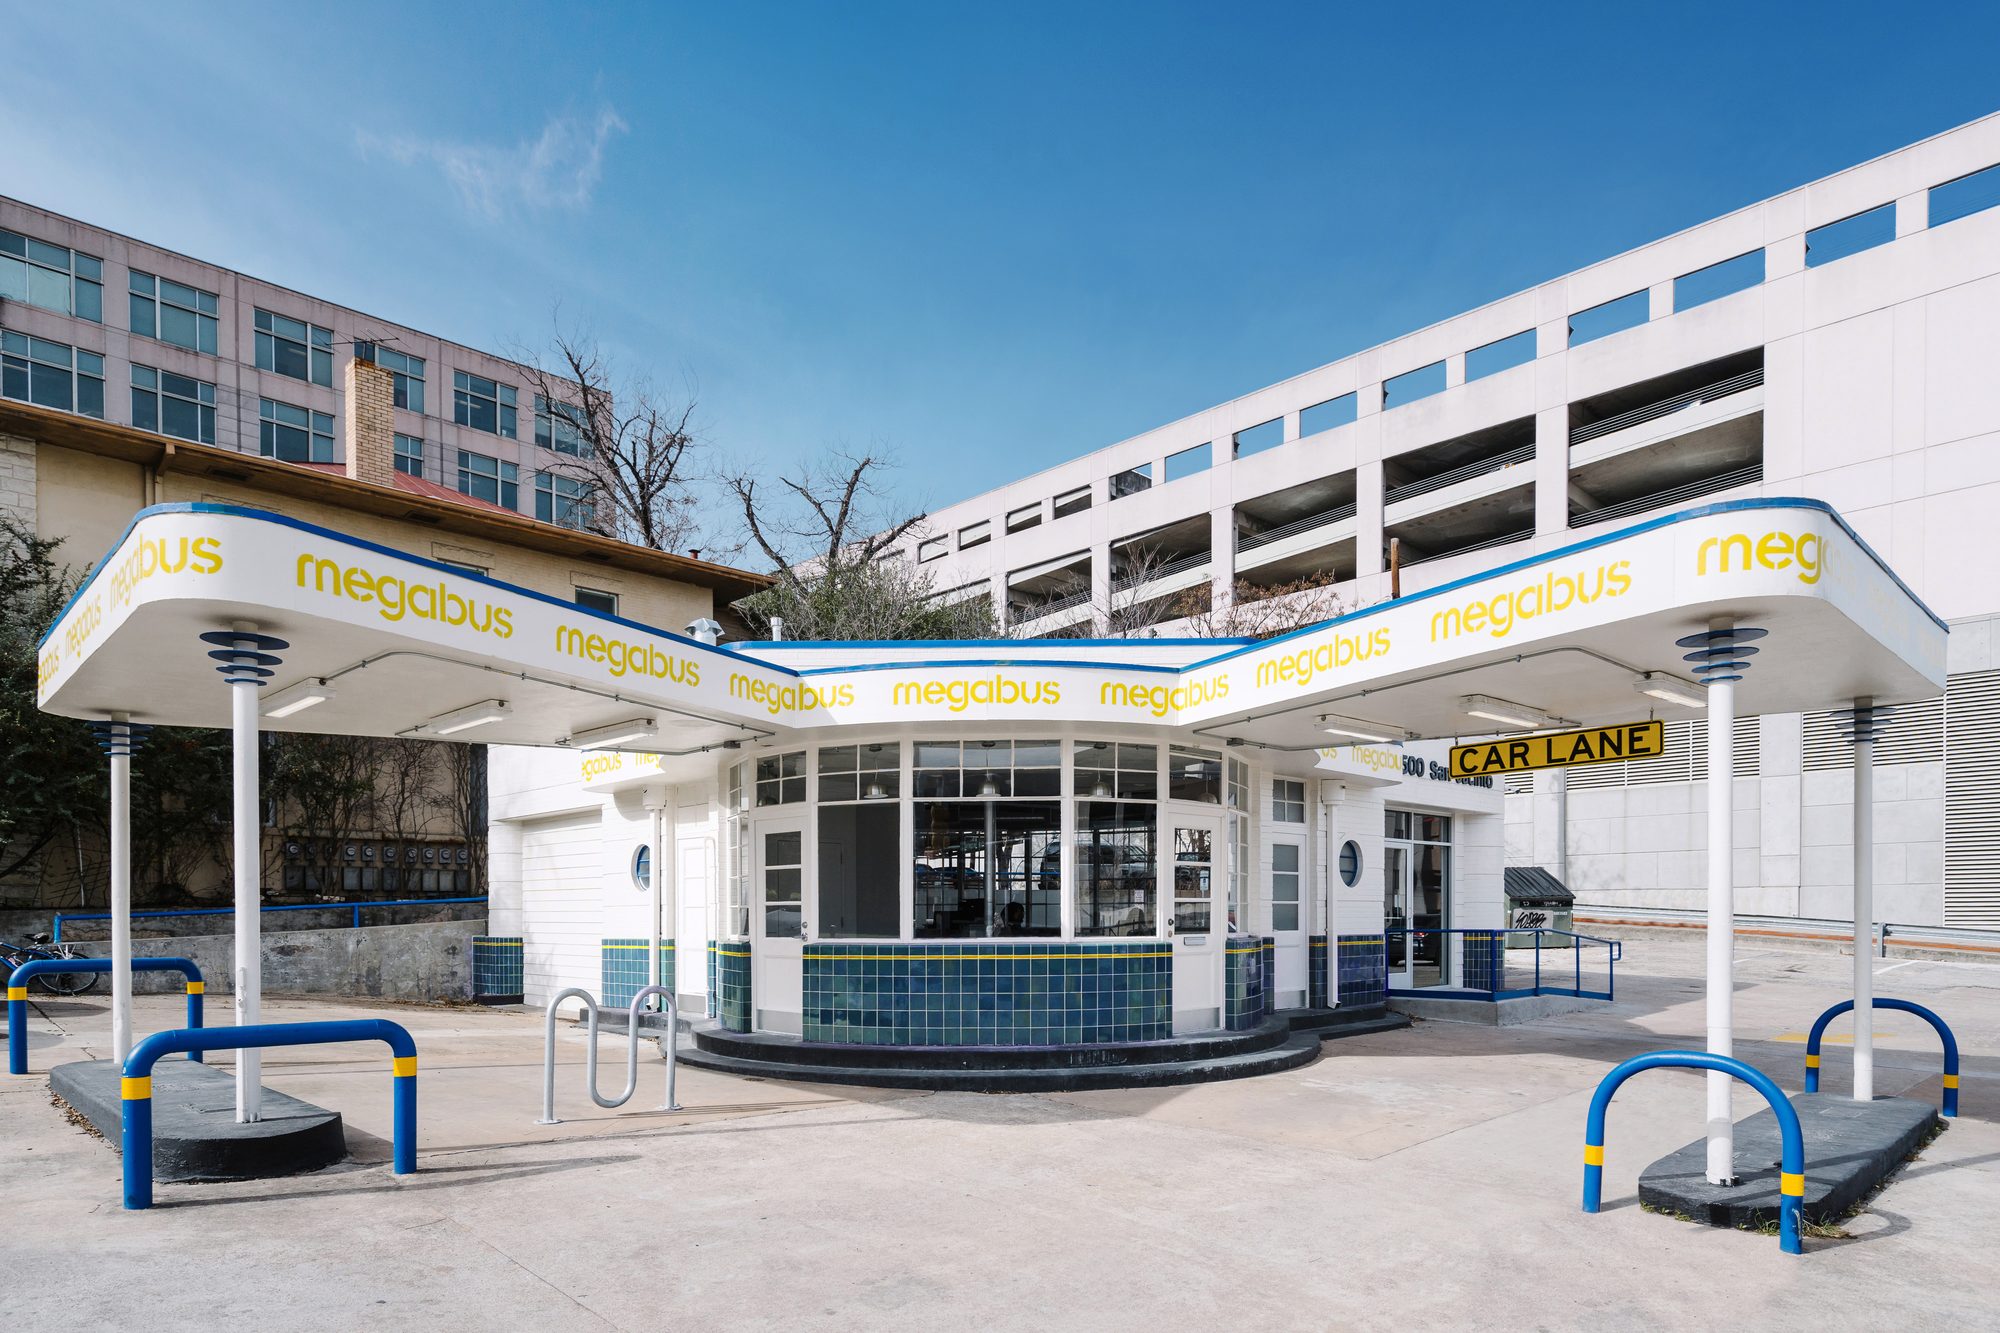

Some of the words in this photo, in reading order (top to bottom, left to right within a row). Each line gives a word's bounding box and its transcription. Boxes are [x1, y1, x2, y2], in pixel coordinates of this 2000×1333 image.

[110, 532, 224, 613] megabus
[297, 551, 513, 640] megabus
[1431, 560, 1632, 643] megabus
[556, 625, 700, 687] megabus
[1256, 627, 1391, 688] megabus
[729, 673, 855, 715] megabus
[893, 674, 1061, 712] megabus
[1100, 673, 1229, 717] megabus
[1403, 755, 1425, 777] 500
[1459, 741, 1530, 773] CAR
[1547, 725, 1651, 764] LANE
